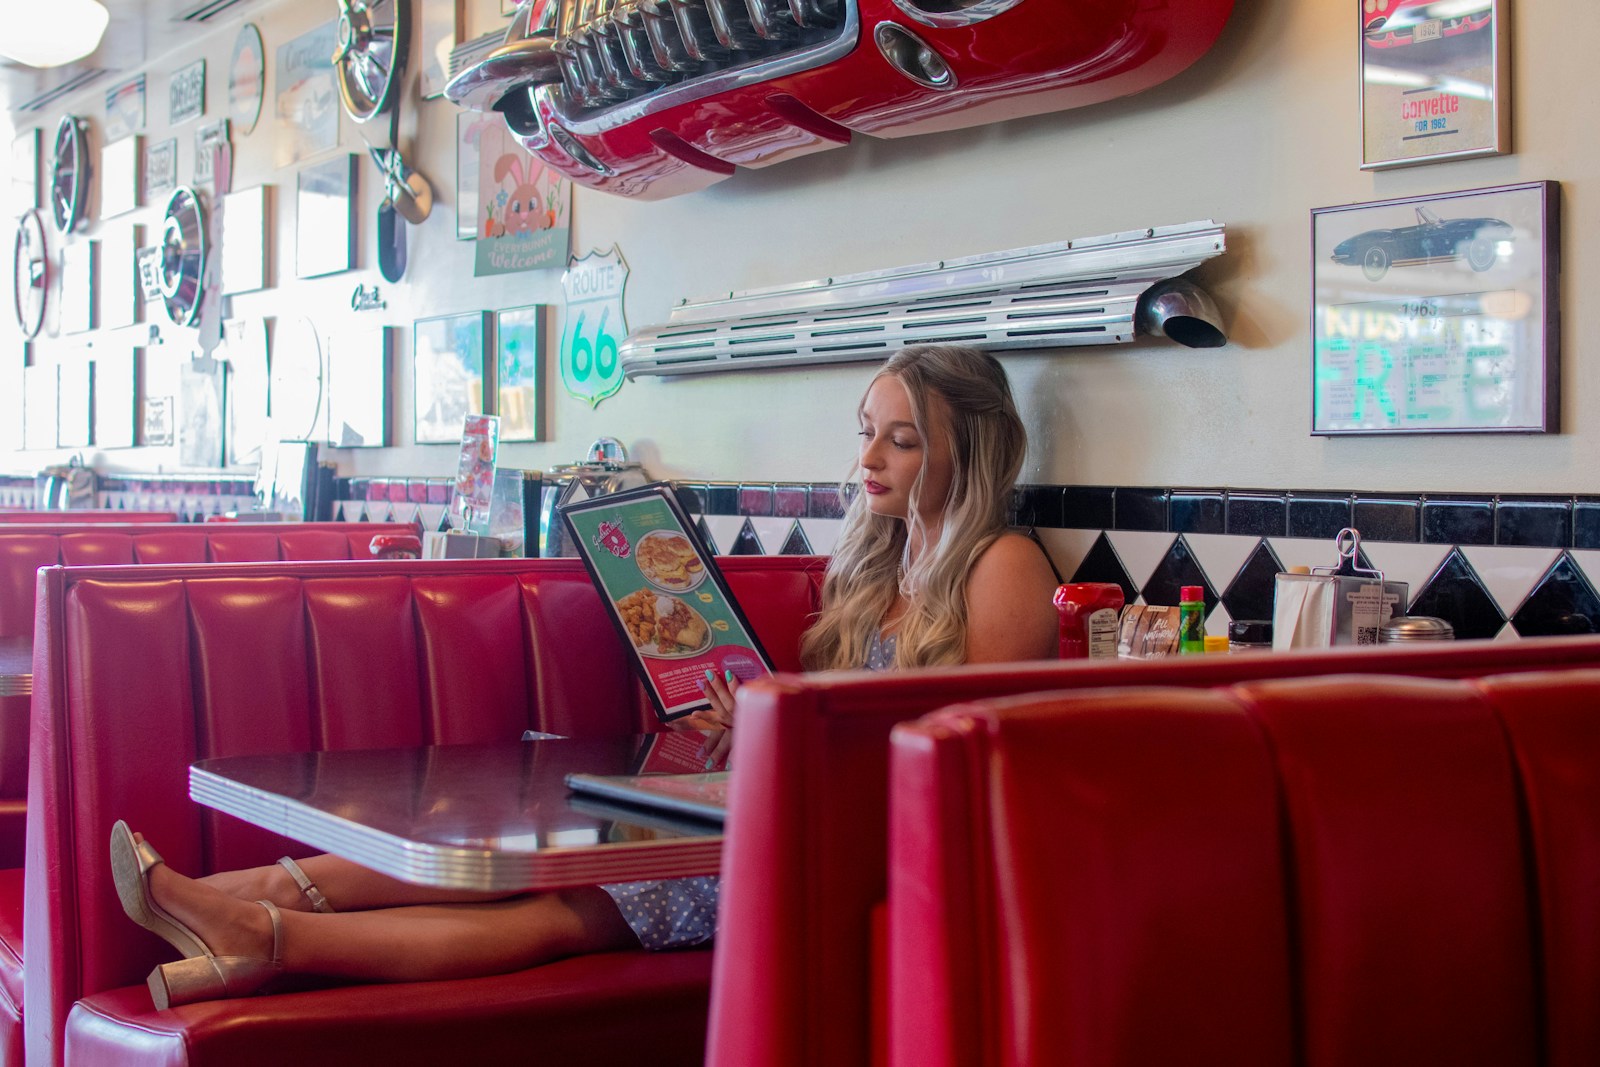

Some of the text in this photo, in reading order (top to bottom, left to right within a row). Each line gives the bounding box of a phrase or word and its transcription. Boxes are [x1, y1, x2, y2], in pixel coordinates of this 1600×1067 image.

[1420, 23, 1436, 37] 1962
[1415, 117, 1447, 132] FOR 1962
[494, 233, 553, 253] EVERYBUNNY
[488, 248, 555, 269] Welcome
[573, 265, 614, 296] ROUTE
[1401, 299, 1438, 320] 1965
[571, 305, 617, 382] 66
[1153, 618, 1168, 630] ALL
[1142, 628, 1174, 642] NATURAL
